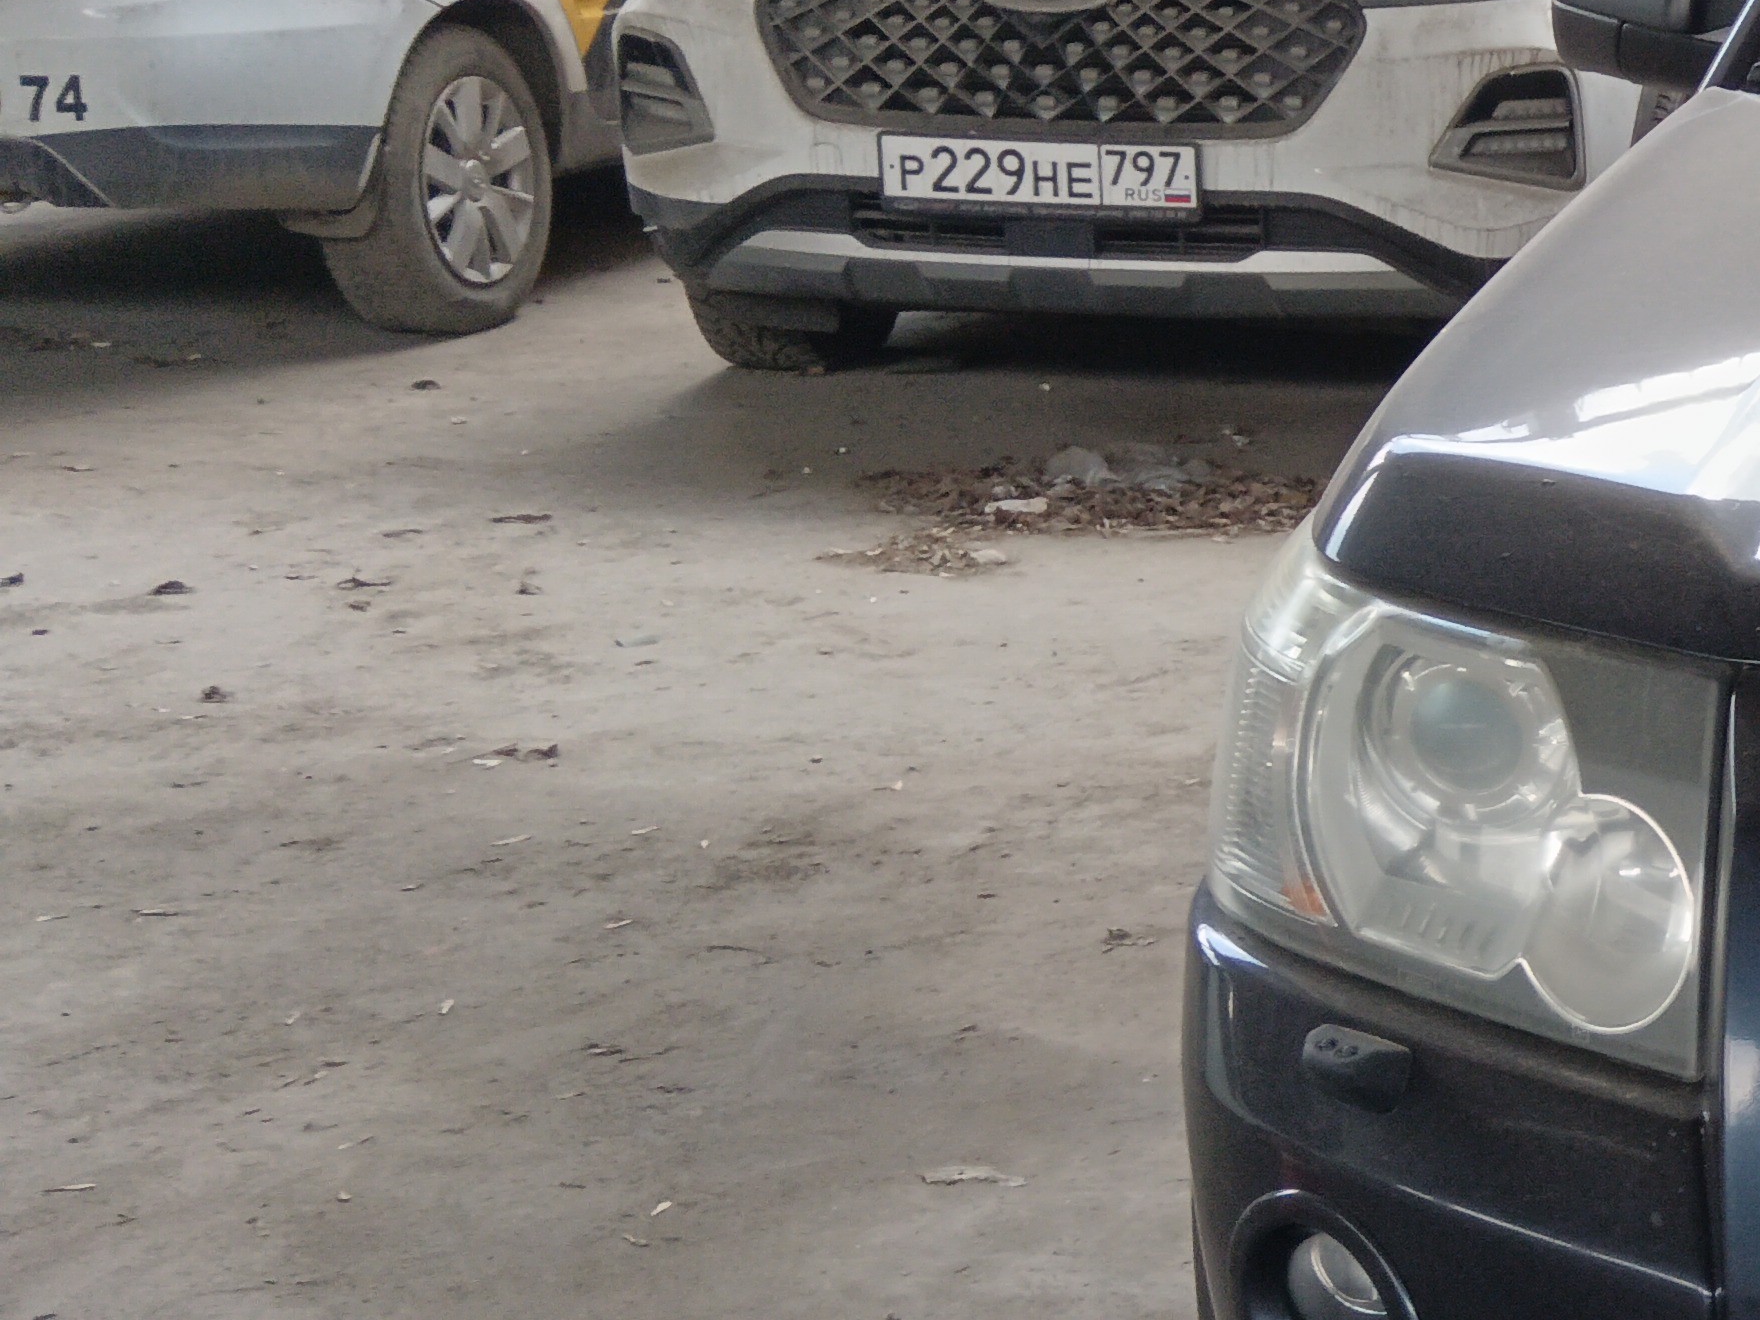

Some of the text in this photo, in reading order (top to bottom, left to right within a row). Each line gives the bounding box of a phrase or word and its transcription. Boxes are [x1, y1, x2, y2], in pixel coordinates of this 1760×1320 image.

[20, 74, 88, 121] 74
[899, 145, 1182, 199] Р229НЕ 797
[1124, 188, 1162, 202] RUS
